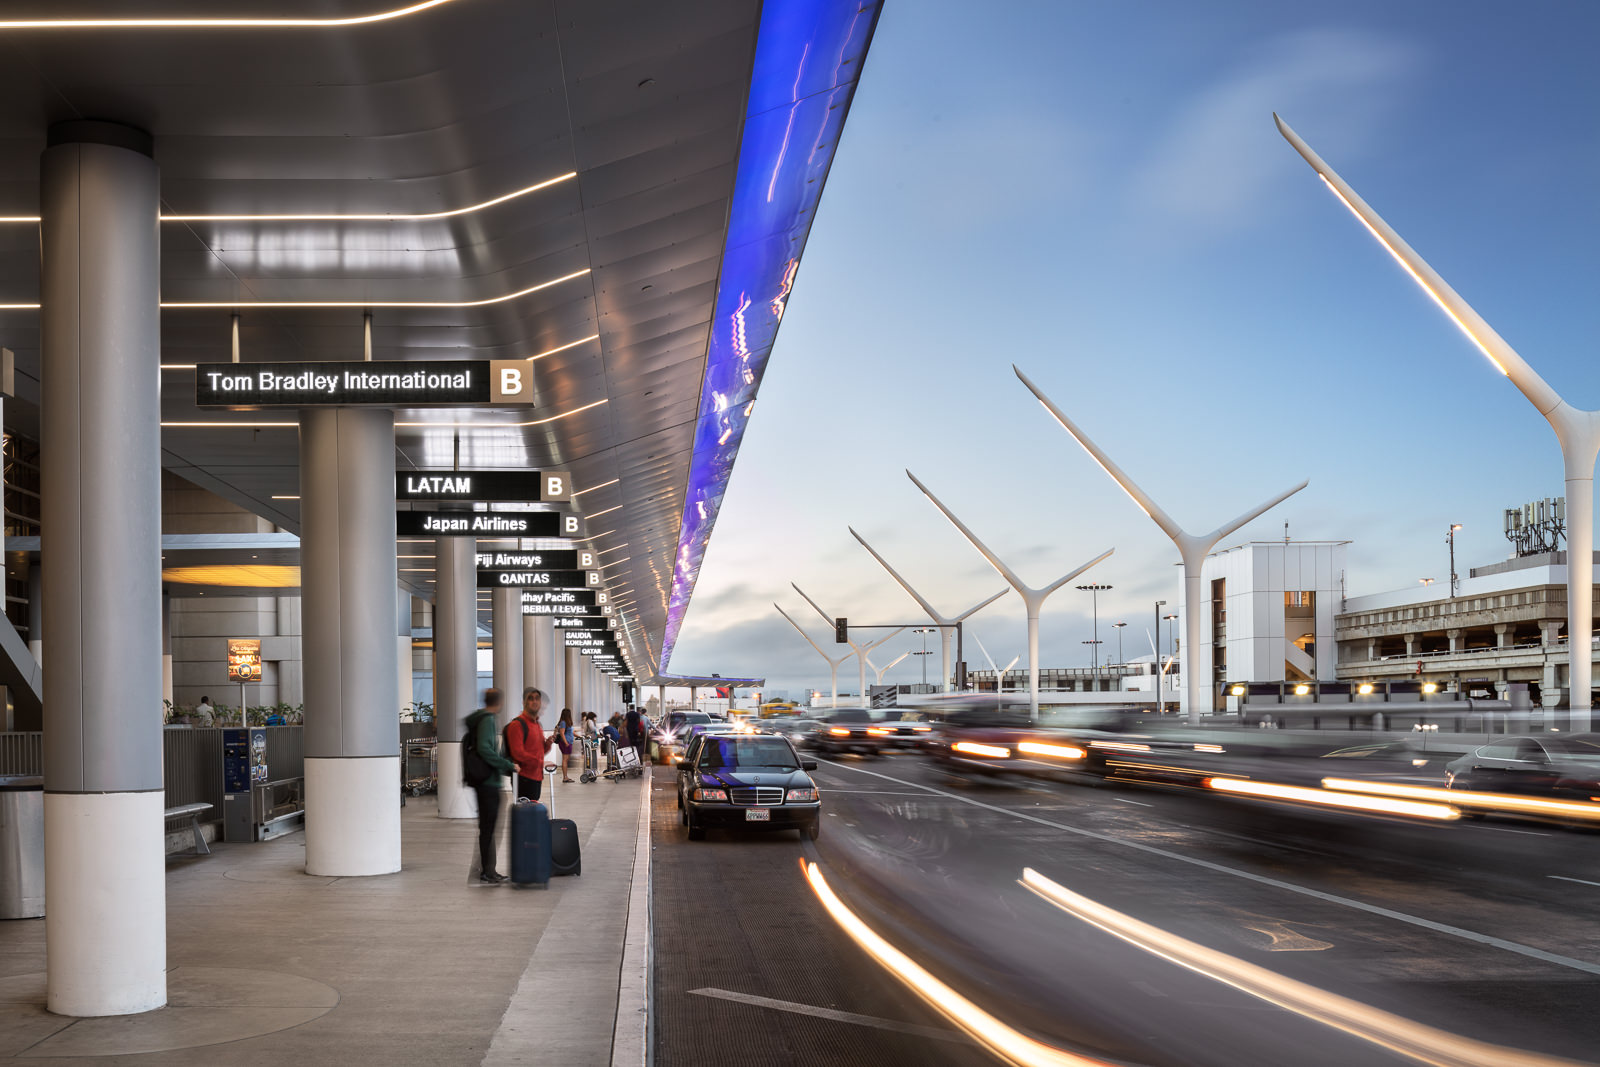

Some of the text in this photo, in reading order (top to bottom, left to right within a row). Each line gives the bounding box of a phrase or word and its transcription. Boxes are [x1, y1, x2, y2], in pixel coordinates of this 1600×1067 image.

[208, 370, 470, 393] Tom Bradley International
[501, 369, 522, 395] B
[408, 478, 470, 494] LATAM
[547, 477, 562, 495] B
[424, 516, 527, 532] Japan Airlines
[565, 517, 578, 532] B
[475, 554, 542, 567] Fiji Airways
[582, 554, 592, 566] B
[500, 574, 550, 584] QANTAS
[589, 574, 599, 584] B
[545, 593, 575, 602] Pacific
[598, 593, 607, 603] B
[610, 619, 617, 627] B
[1416, 661, 1422, 674] 3
